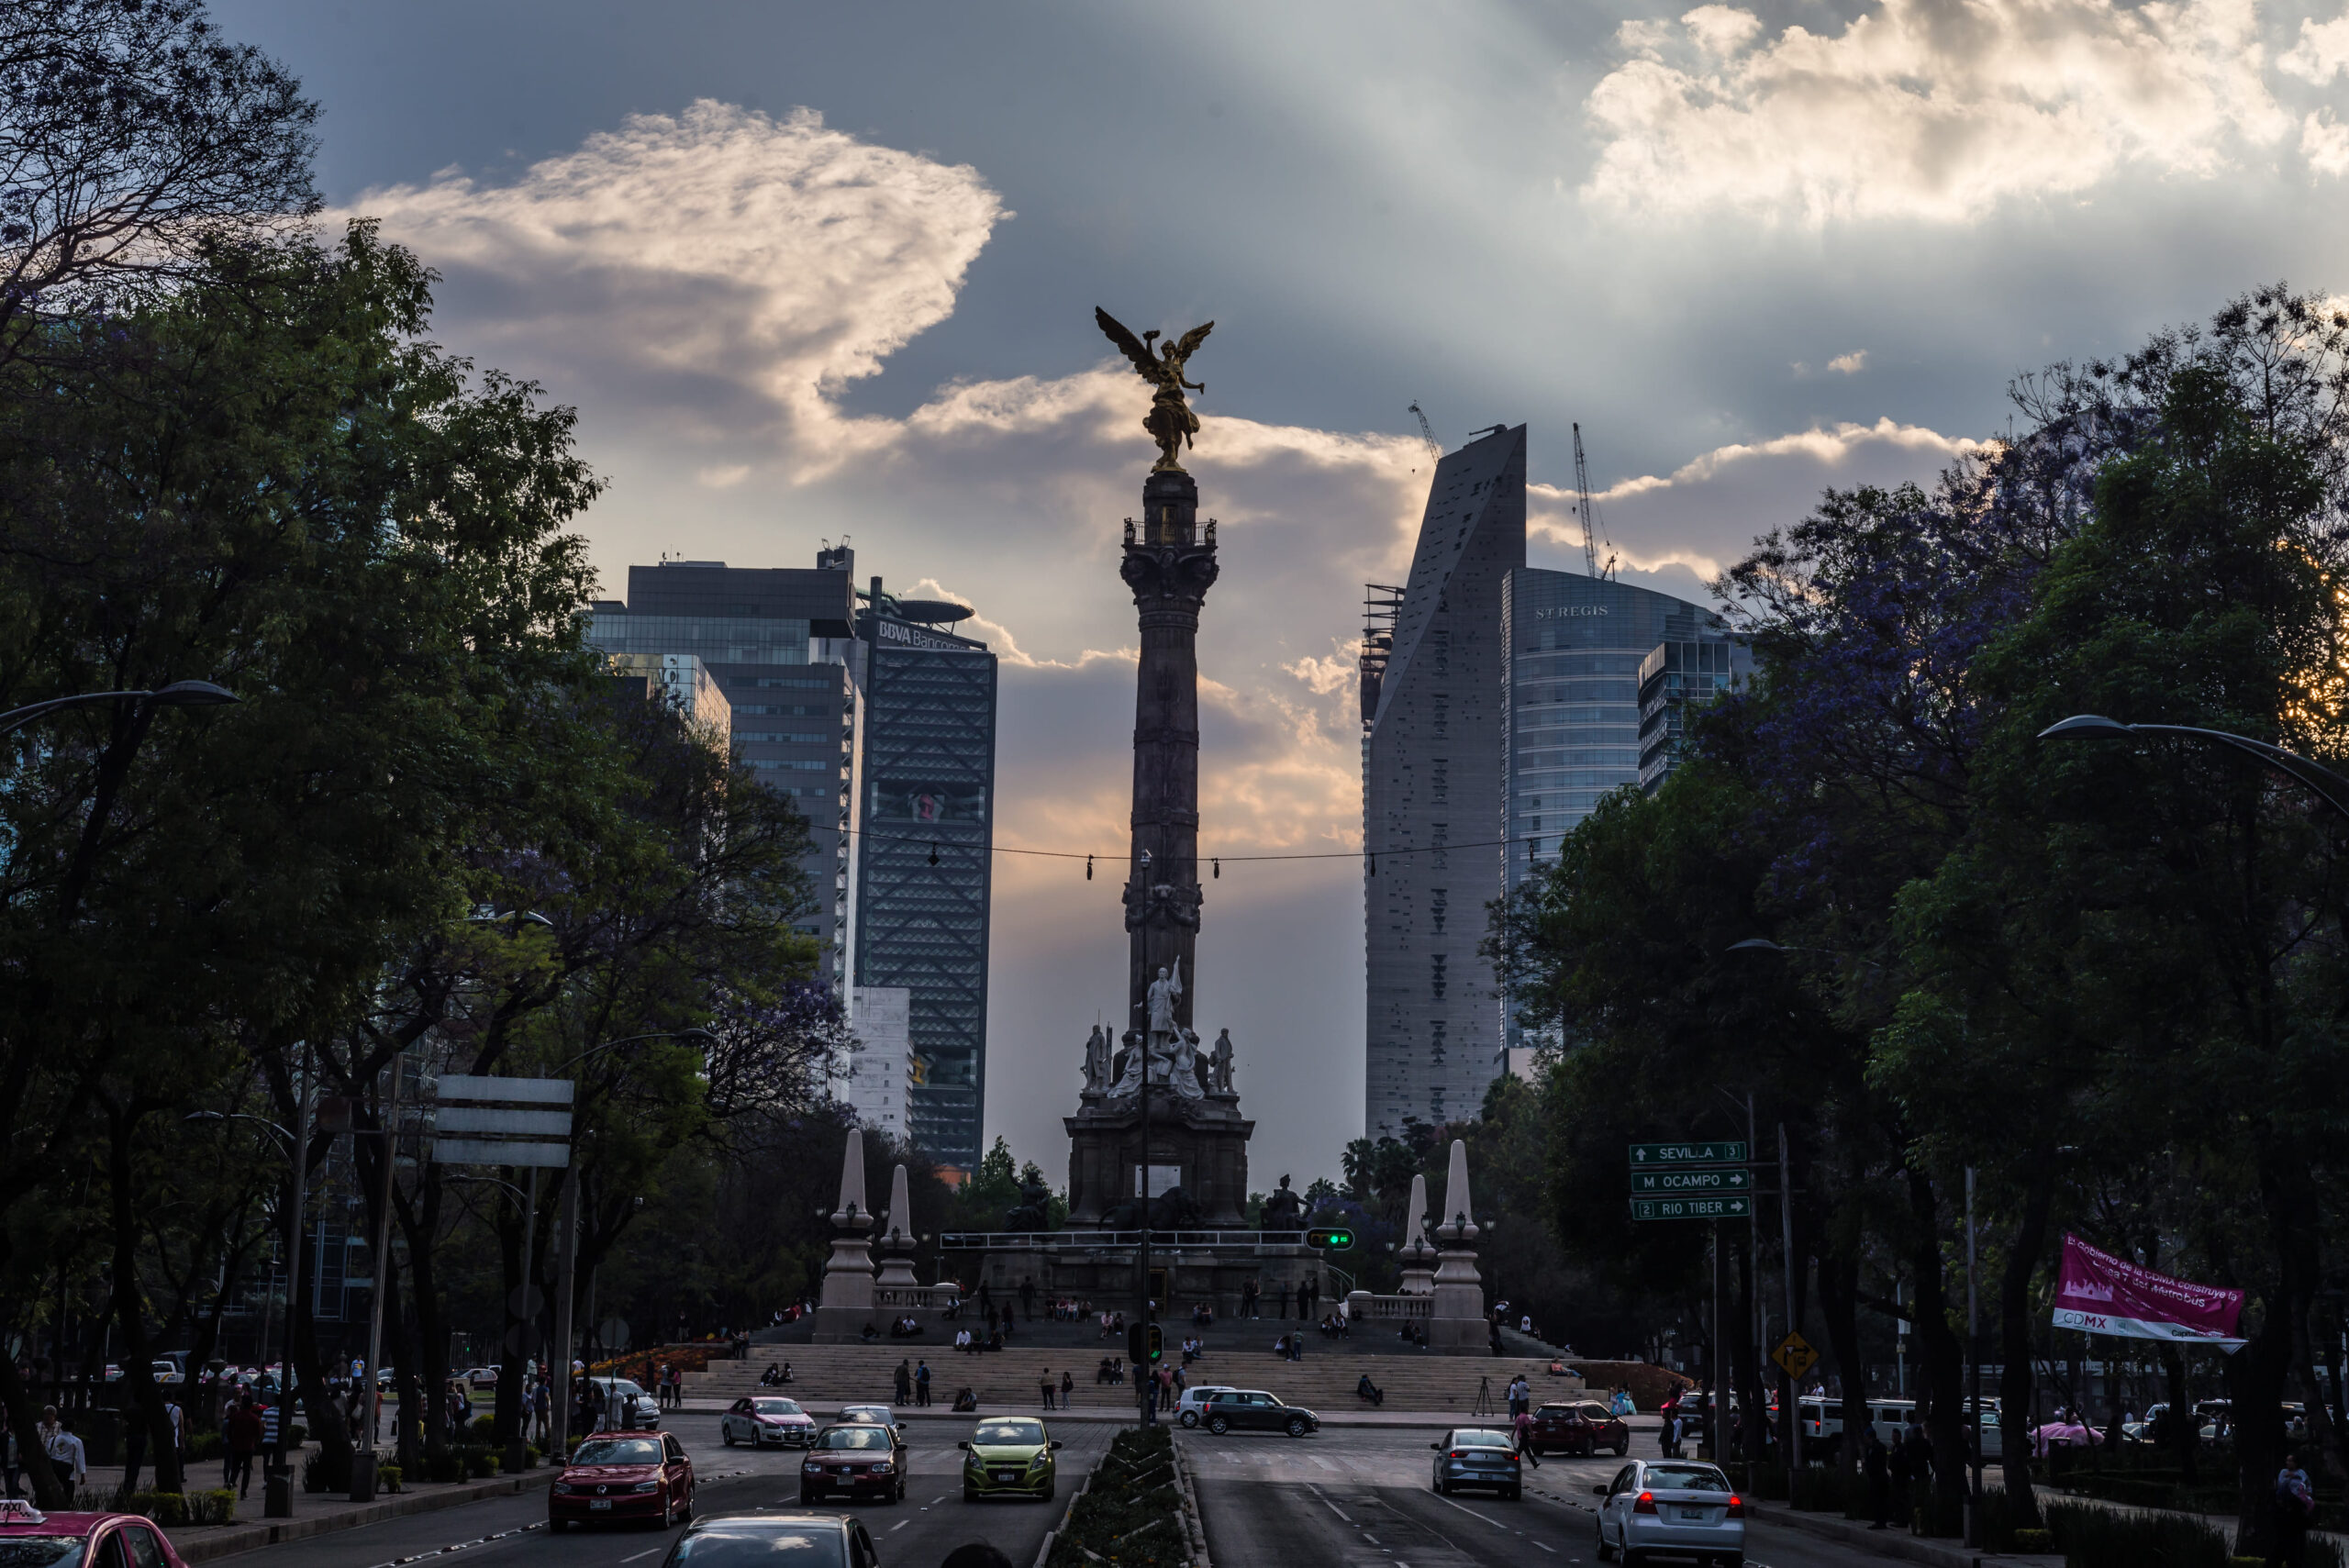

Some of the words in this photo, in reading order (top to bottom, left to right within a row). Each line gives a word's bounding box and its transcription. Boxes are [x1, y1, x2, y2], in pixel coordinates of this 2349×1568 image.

[1558, 606, 1609, 617] REGIS
[878, 621, 911, 644] BBVA
[1659, 1146, 1714, 1160] SEVILLA
[1643, 1175, 1654, 1188] M
[1663, 1174, 1720, 1187] OCAMPO
[1662, 1203, 1683, 1216] RIO
[1688, 1201, 1723, 1214] TIBER
[2120, 1262, 2132, 1272] de
[2177, 1281, 2226, 1299] construye
[2228, 1291, 2237, 1301] la
[2064, 1312, 2107, 1329] CDMX
